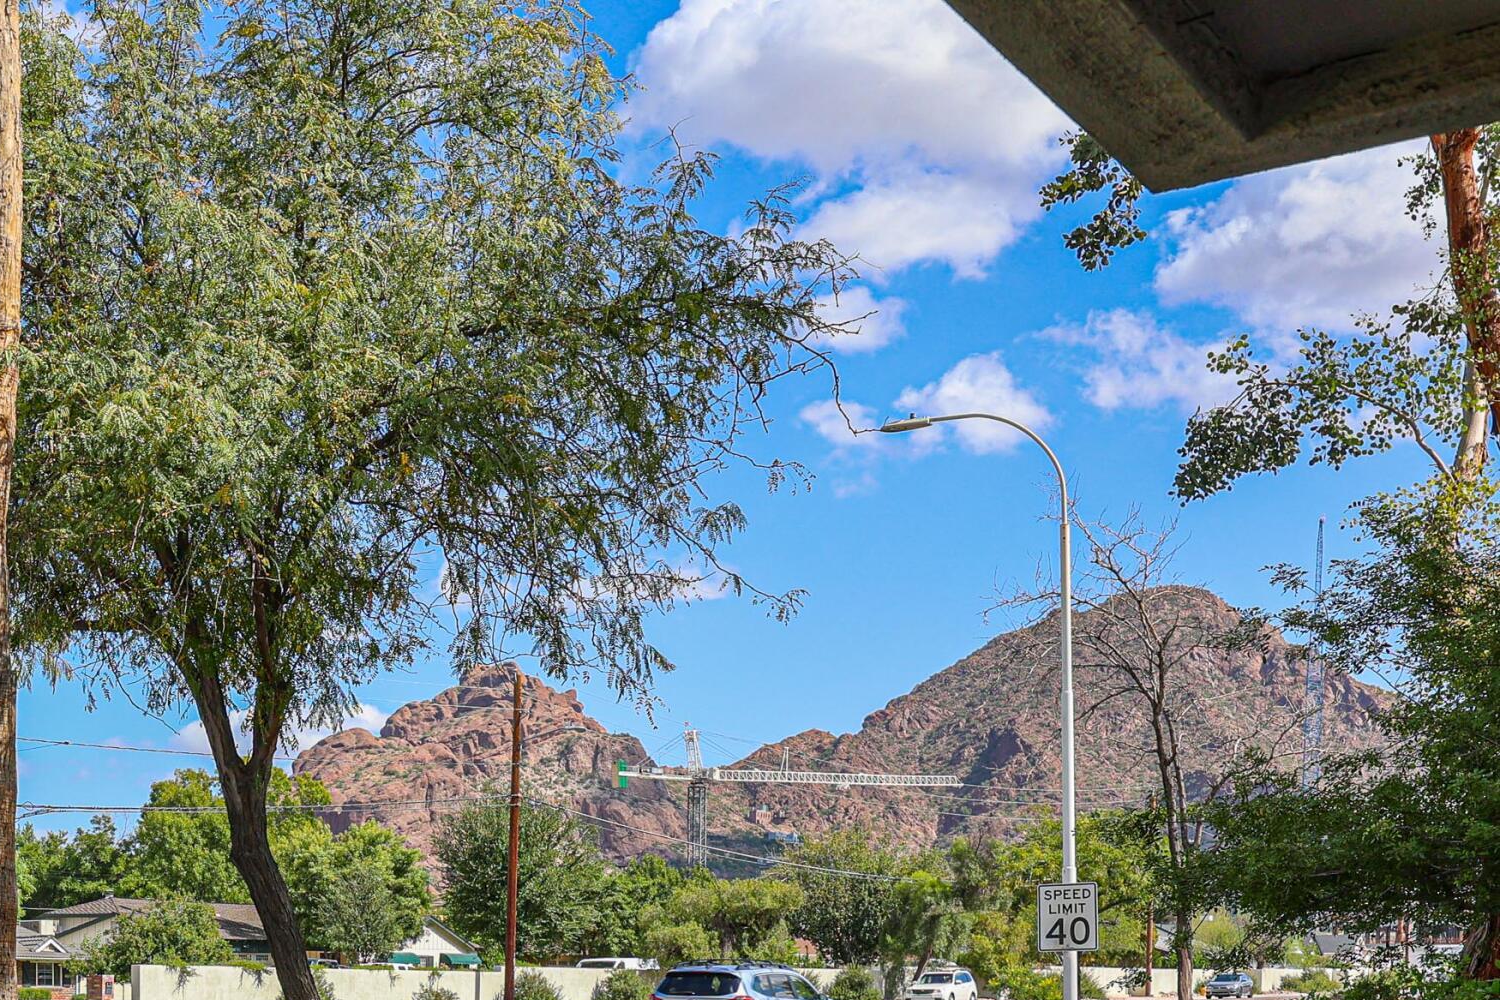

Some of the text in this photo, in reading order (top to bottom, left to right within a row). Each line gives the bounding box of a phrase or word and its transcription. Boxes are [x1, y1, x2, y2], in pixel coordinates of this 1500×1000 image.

[1044, 888, 1091, 900] SPEED
[1048, 902, 1086, 915] LIMIT
[1045, 916, 1090, 945] 40
